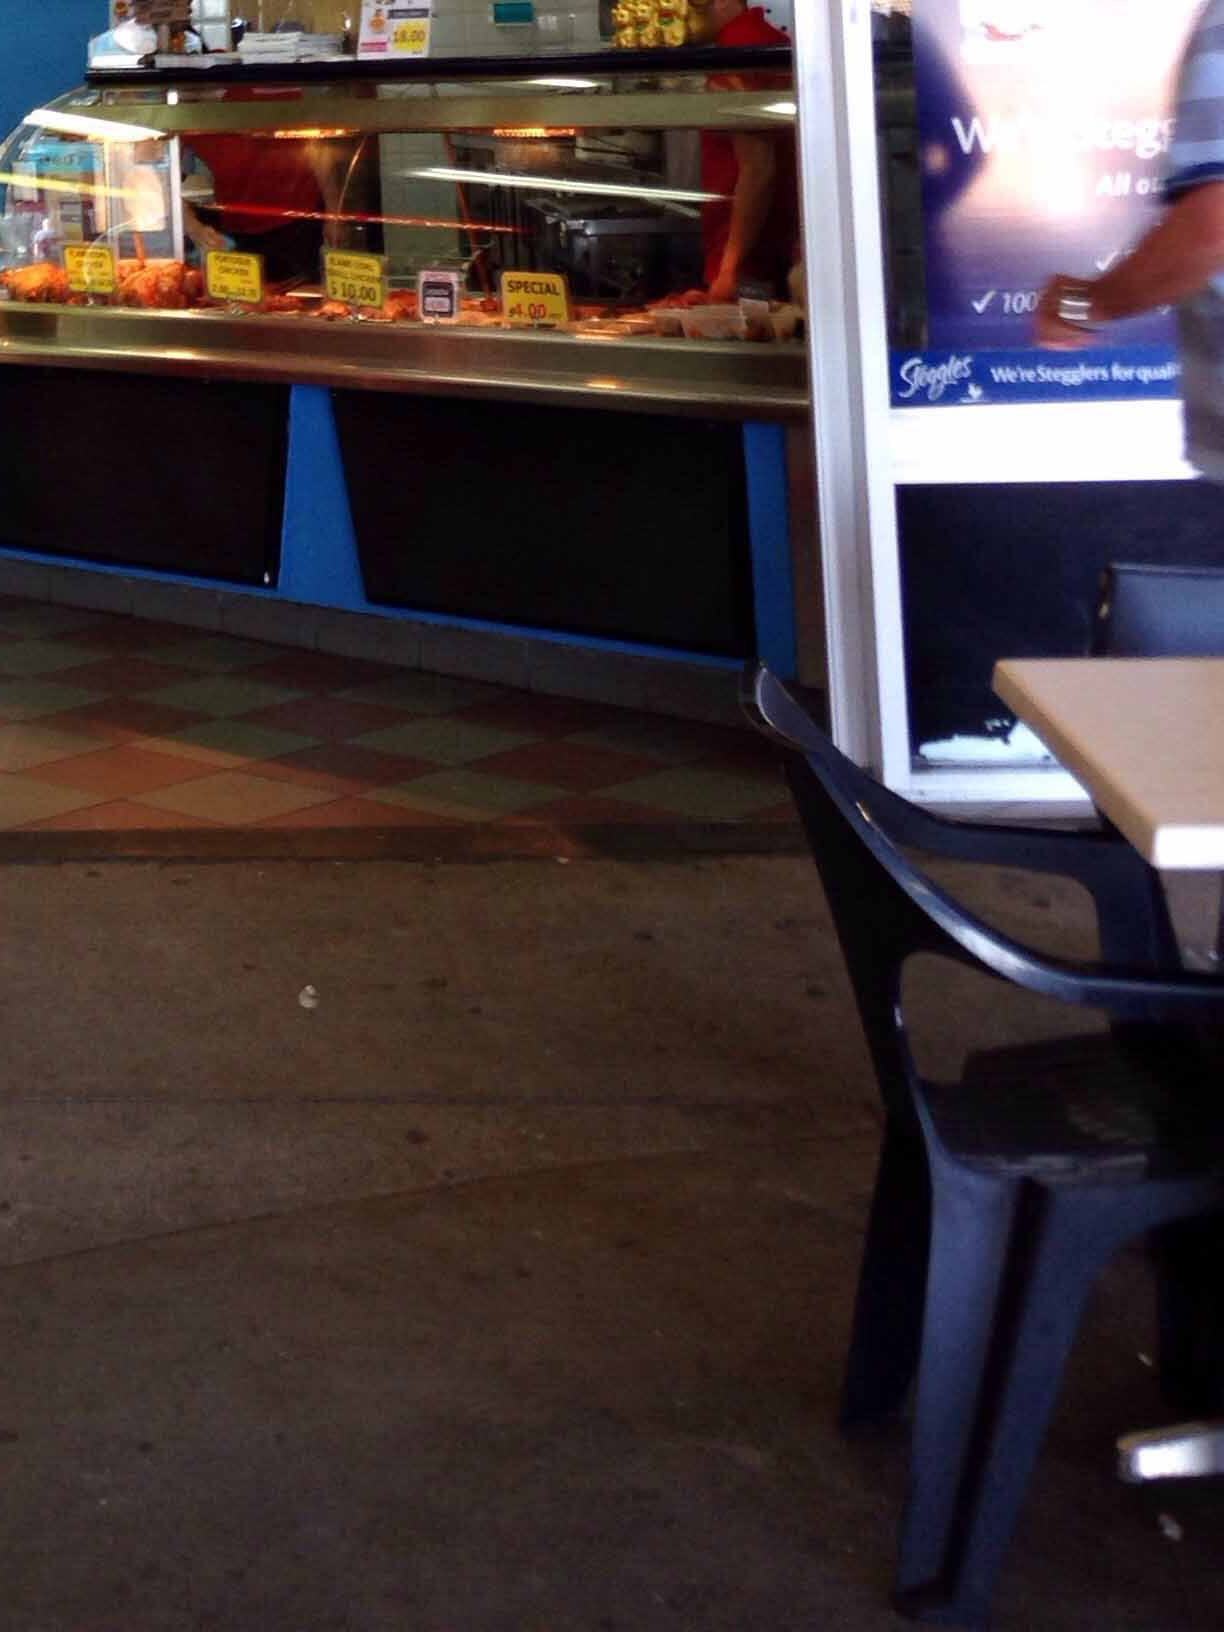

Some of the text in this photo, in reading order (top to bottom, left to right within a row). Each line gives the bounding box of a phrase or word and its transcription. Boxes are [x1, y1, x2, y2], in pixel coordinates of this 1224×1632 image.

[342, 284, 376, 303] 10.00
[507, 279, 560, 297] SPECIAL
[1002, 289, 1040, 313] 100
[1037, 364, 1108, 387] Stegglers
[1112, 364, 1134, 382] for
[1136, 362, 1180, 384] quali
